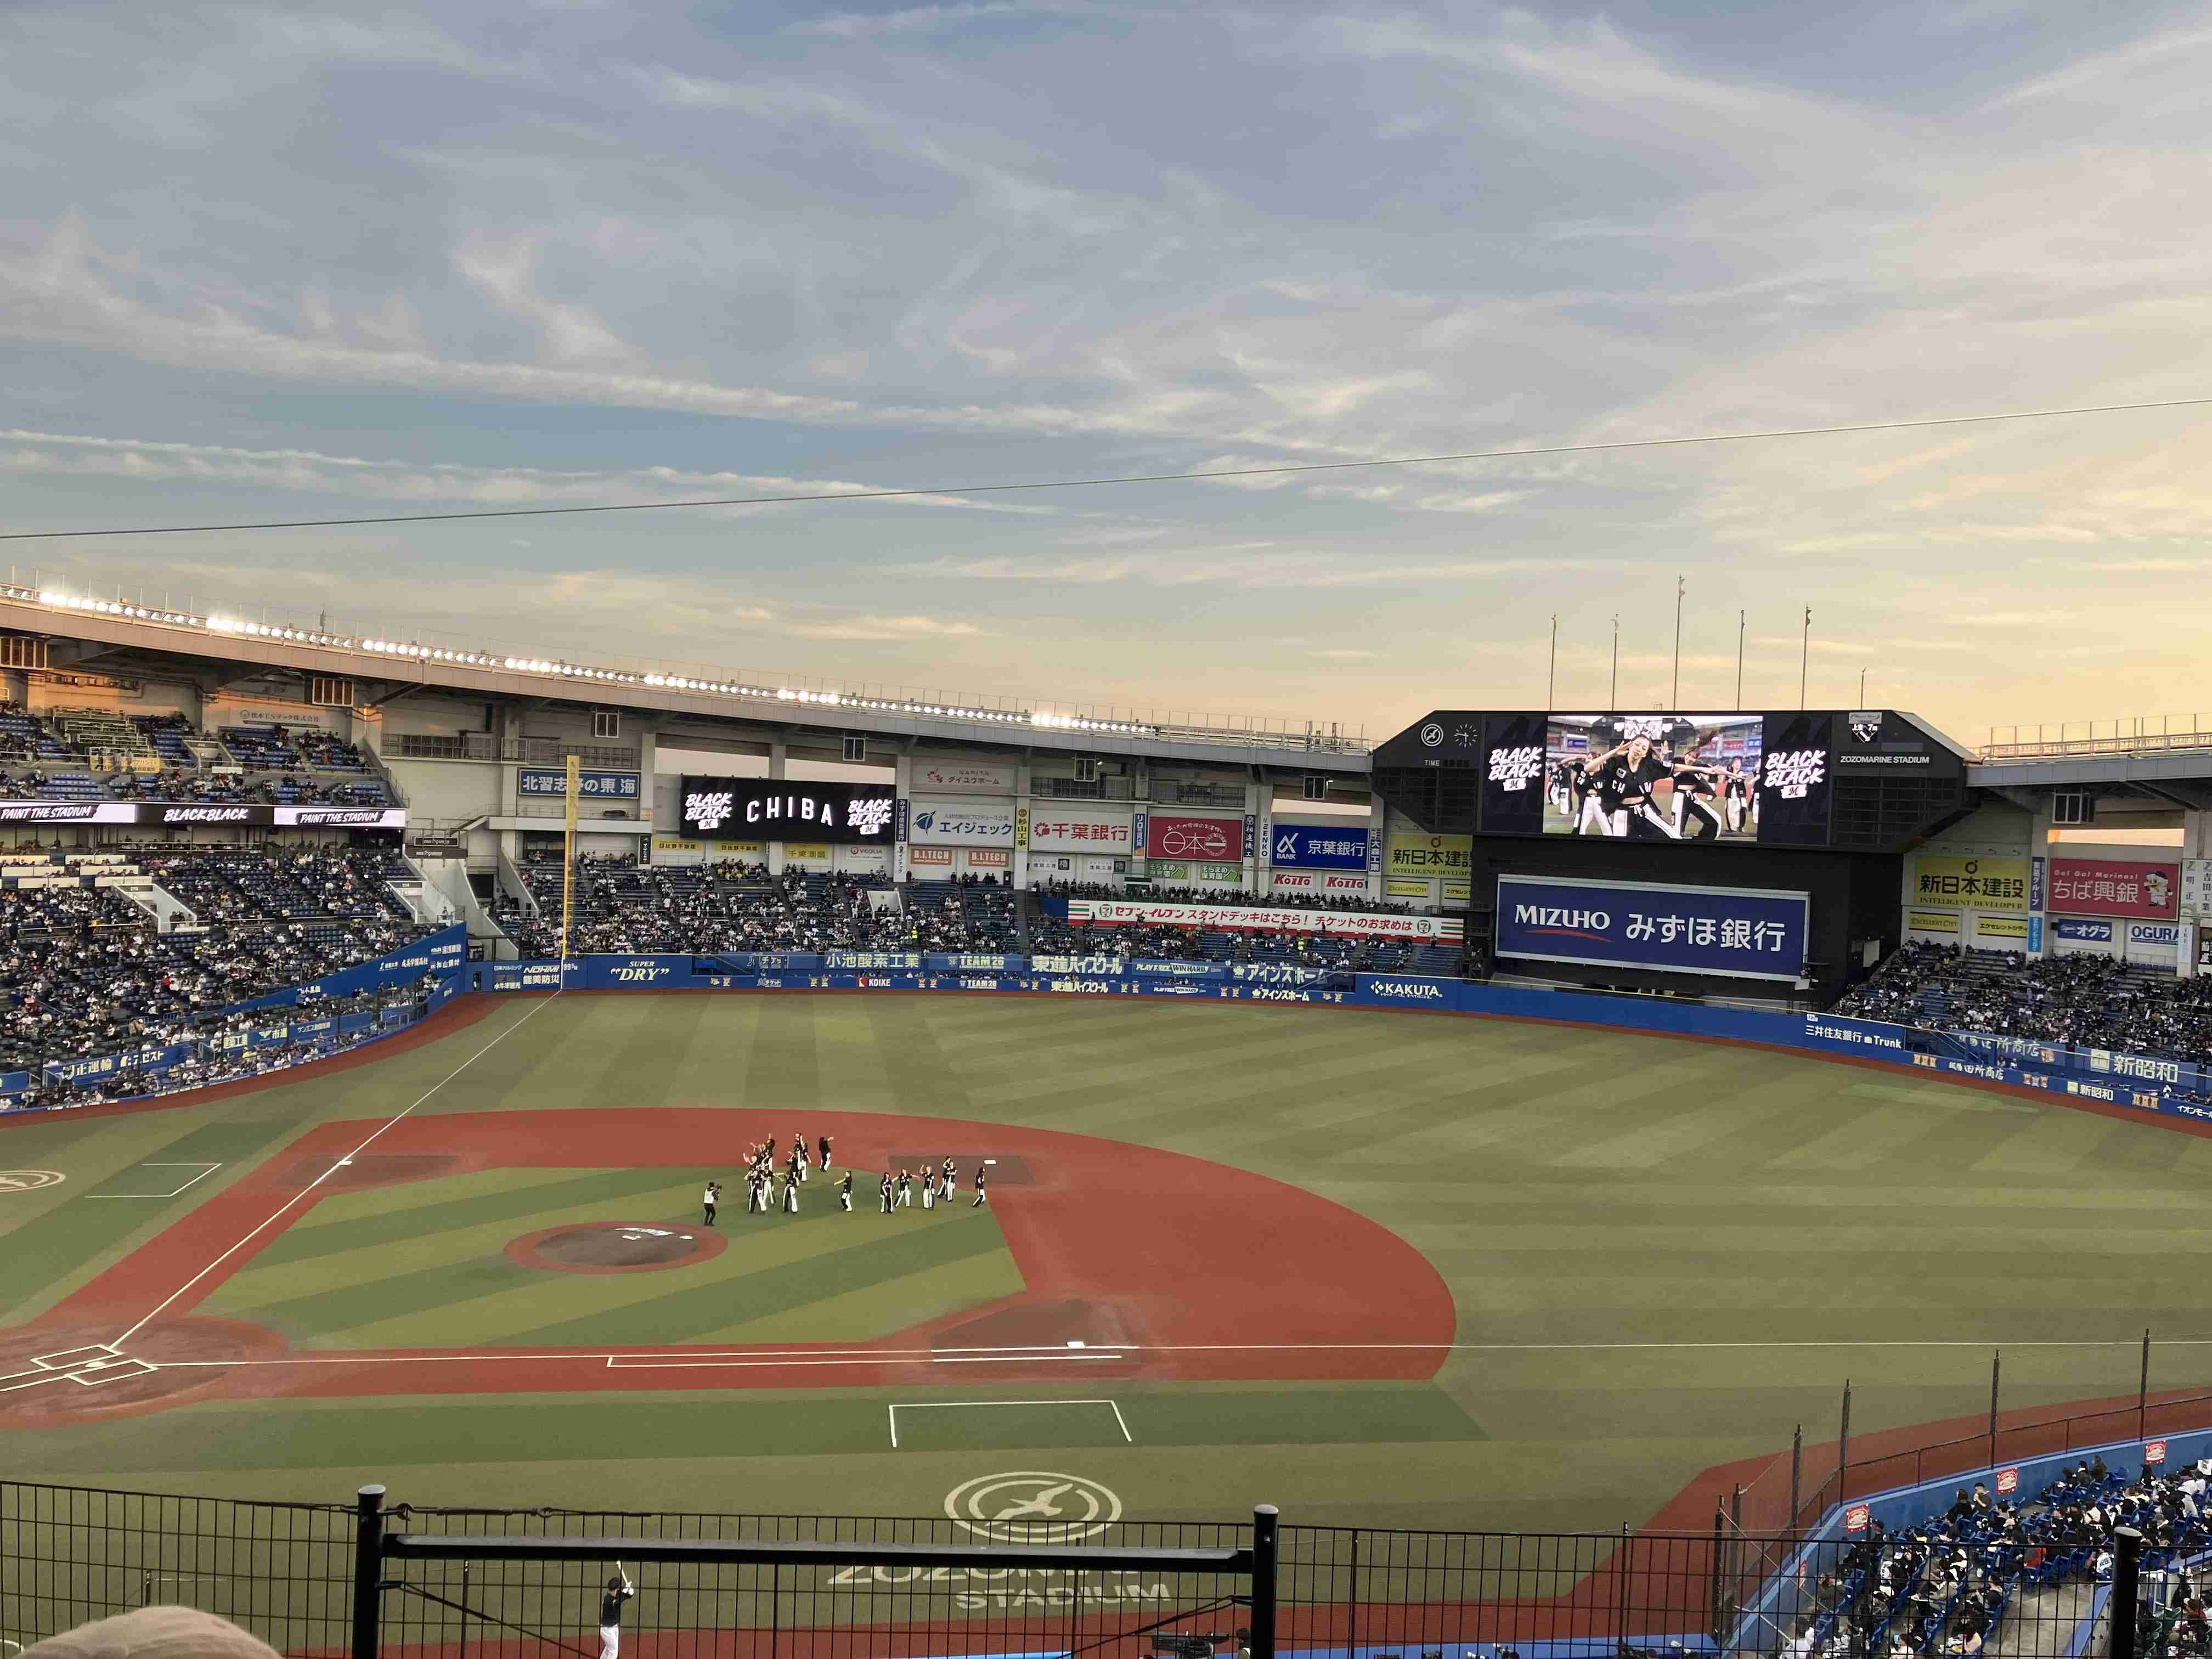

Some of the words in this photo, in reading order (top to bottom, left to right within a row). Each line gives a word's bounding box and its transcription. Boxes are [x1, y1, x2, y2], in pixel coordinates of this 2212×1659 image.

[1489, 747, 1543, 765] BLACK
[1765, 750, 1826, 769] BLACK
[1488, 763, 1542, 781] BLACK
[1764, 768, 1825, 787] BLACK
[523, 776, 636, 793] 北習志の東海
[948, 776, 1000, 785] ダイユウホーム
[686, 793, 732, 806] BLACK
[849, 799, 893, 812] BLACK
[1, 808, 30, 819] PAINT
[31, 808, 50, 819] THE
[50, 806, 92, 817] STADIUM
[300, 813, 325, 823] PAINT
[325, 812, 343, 822] THE
[343, 812, 378, 822] STADIUM
[685, 806, 732, 820] BLACK
[747, 797, 832, 826] CHIBA
[848, 812, 891, 826] BLACK
[939, 822, 1013, 835] エイジェック
[1018, 818, 1027, 846] 杉山工事
[1052, 823, 1128, 841] 千葉銀行
[914, 850, 949, 859] B.I.TECH
[1307, 840, 1365, 856] 京葉銀行
[972, 852, 1006, 861] B.I.TECH
[1392, 849, 1472, 867] 新日本建設
[1920, 875, 2024, 899] 新日本建設
[2053, 880, 2138, 904] ちば興銀
[1920, 897, 1971, 905] INTELLIGENT
[1974, 900, 2022, 909] DEVELOPER
[1315, 916, 1413, 930] チケットのお求めは
[1515, 905, 1610, 929] MIZUHO
[1626, 914, 1786, 951] みずほ銀行
[2077, 924, 2111, 938] オグラ
[826, 953, 921, 968] 小池酸素工業
[1031, 956, 1122, 975] 東進ハイスクール
[523, 965, 560, 973] NOHMI
[523, 974, 560, 985] 能美防災
[868, 979, 890, 987] KOIKE
[1051, 981, 1109, 993] 東進ハイスクール
[1385, 983, 1440, 996] KAKUTA
[1261, 989, 1310, 1001] アインスホーム
[1805, 1025, 1863, 1043] 三井住友銀行
[1873, 1035, 1901, 1048] Trunk
[2114, 1054, 2179, 1083] 新昭和
[2080, 1084, 2114, 1101] 新昭和
[956, 1583, 1171, 1609] STADIUM
